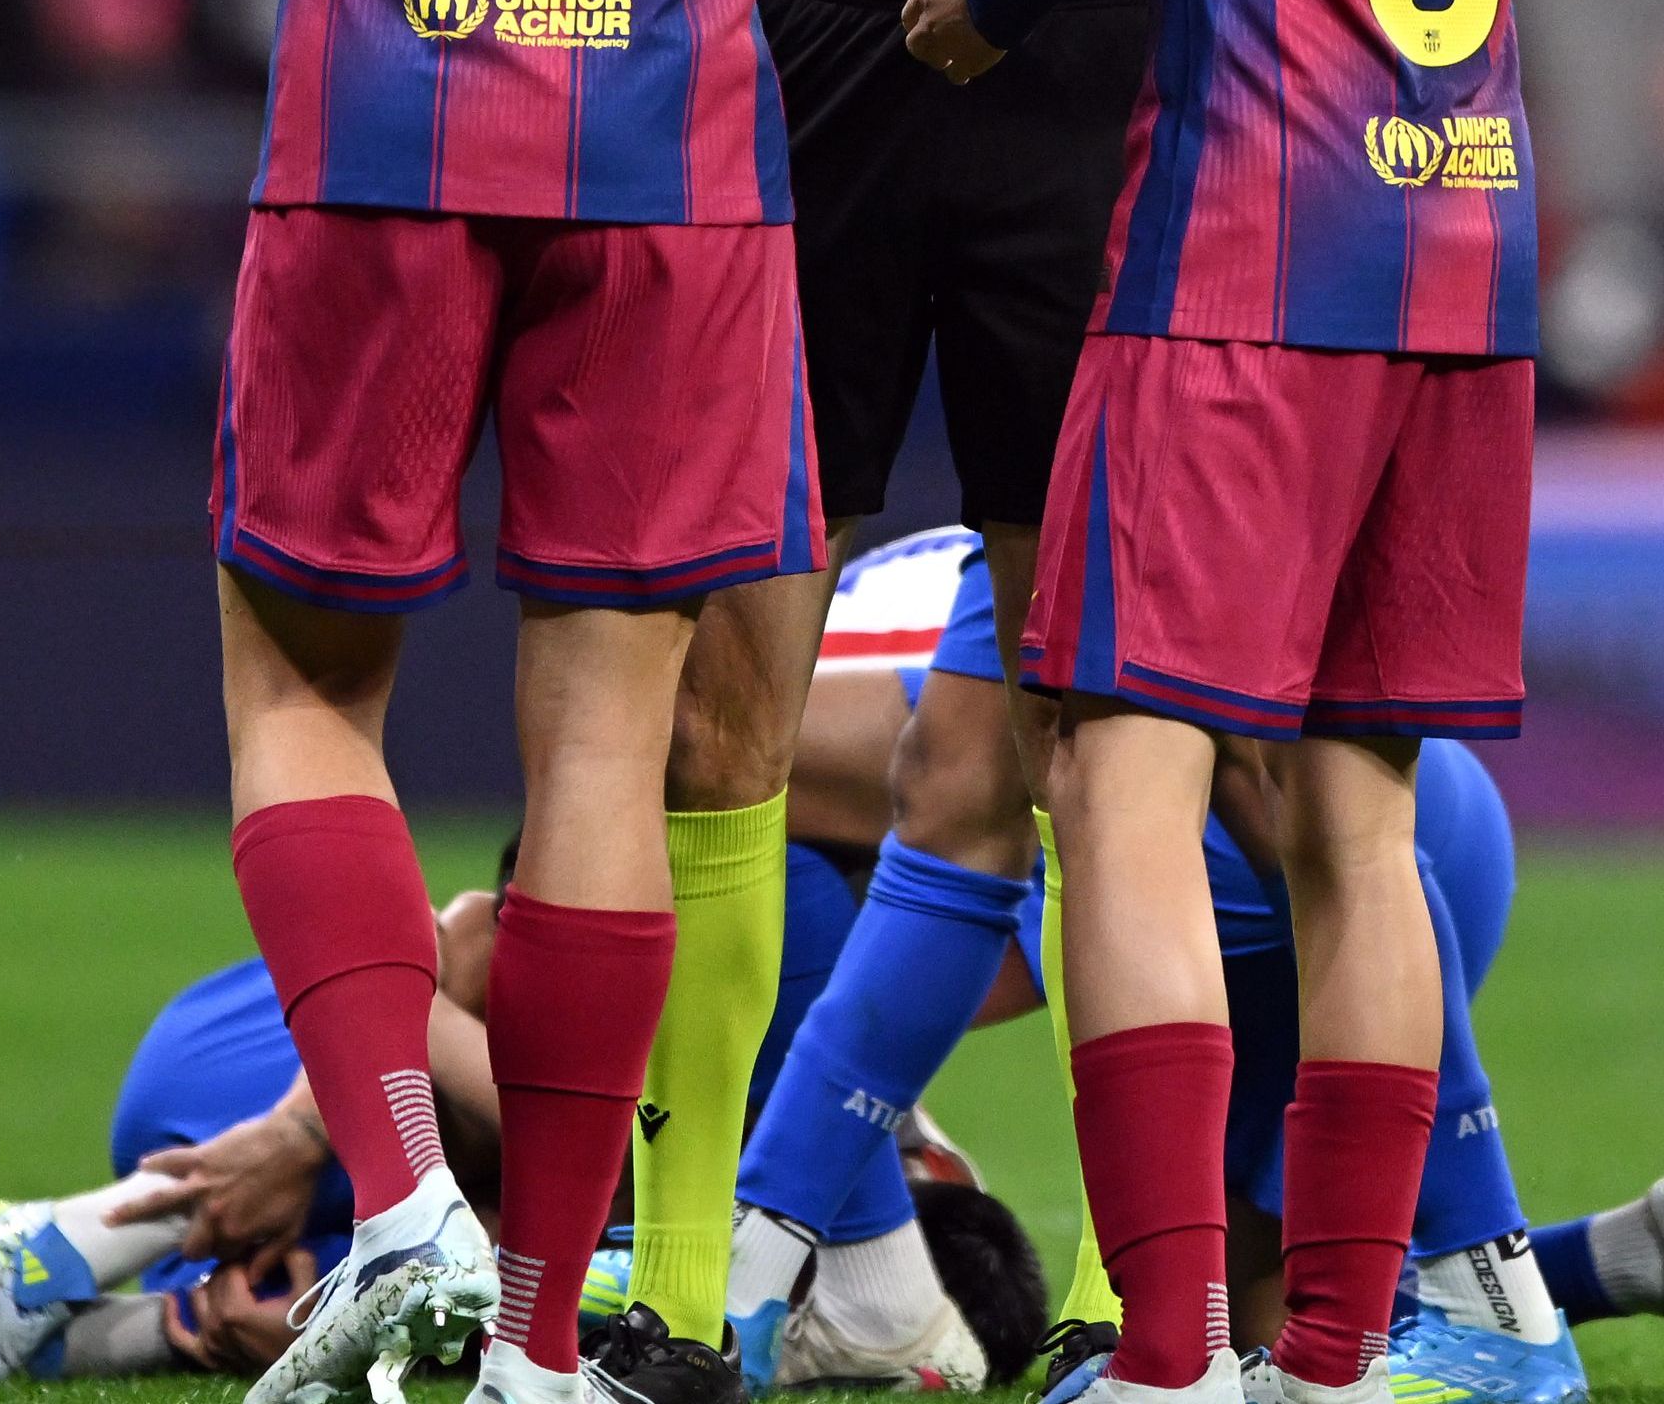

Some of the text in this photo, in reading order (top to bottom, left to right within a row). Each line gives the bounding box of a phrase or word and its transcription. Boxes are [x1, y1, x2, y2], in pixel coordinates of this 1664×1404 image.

[493, 10, 631, 37] ACNUR
[1441, 116, 1513, 146] UNHCR
[1441, 147, 1518, 177] ACNUR
